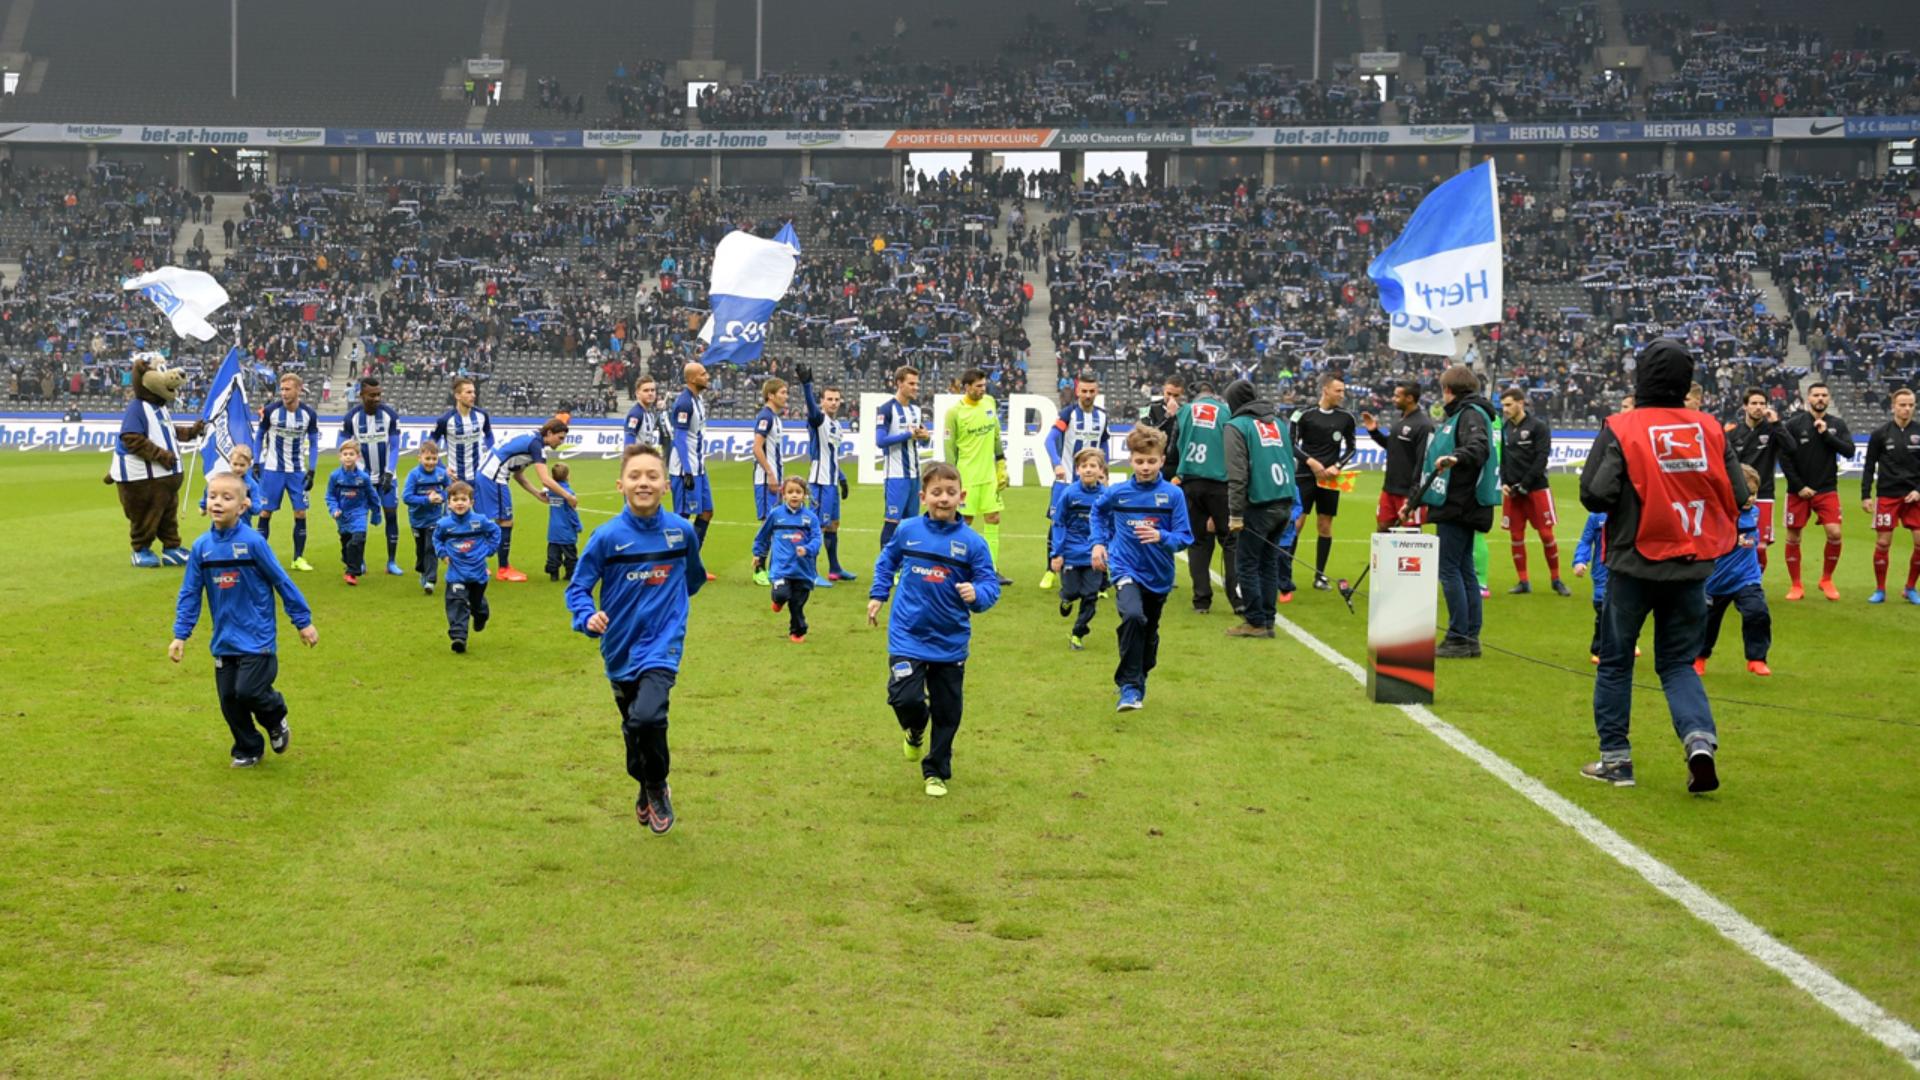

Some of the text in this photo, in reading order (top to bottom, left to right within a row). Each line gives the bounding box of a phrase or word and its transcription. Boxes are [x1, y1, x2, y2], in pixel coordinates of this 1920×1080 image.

[141, 127, 249, 144] bet-at-home
[375, 131, 534, 145] WE TRY. WE FAIL. WE WIN.
[896, 132, 932, 145] SPORT
[934, 131, 954, 145] FÜR
[957, 132, 1039, 144] ENTWICKLUNG
[1061, 130, 1185, 144] 1.000 Chancen für Afrika
[1273, 128, 1390, 145] bet-at-home
[1509, 125, 1600, 140] HERTHA BSC
[1643, 123, 1736, 138] HERTHA BSC
[660, 132, 768, 148] bet-at-home
[1185, 442, 1208, 464] 28
[1877, 512, 1892, 526] 33
[1399, 540, 1433, 549] Hermes
